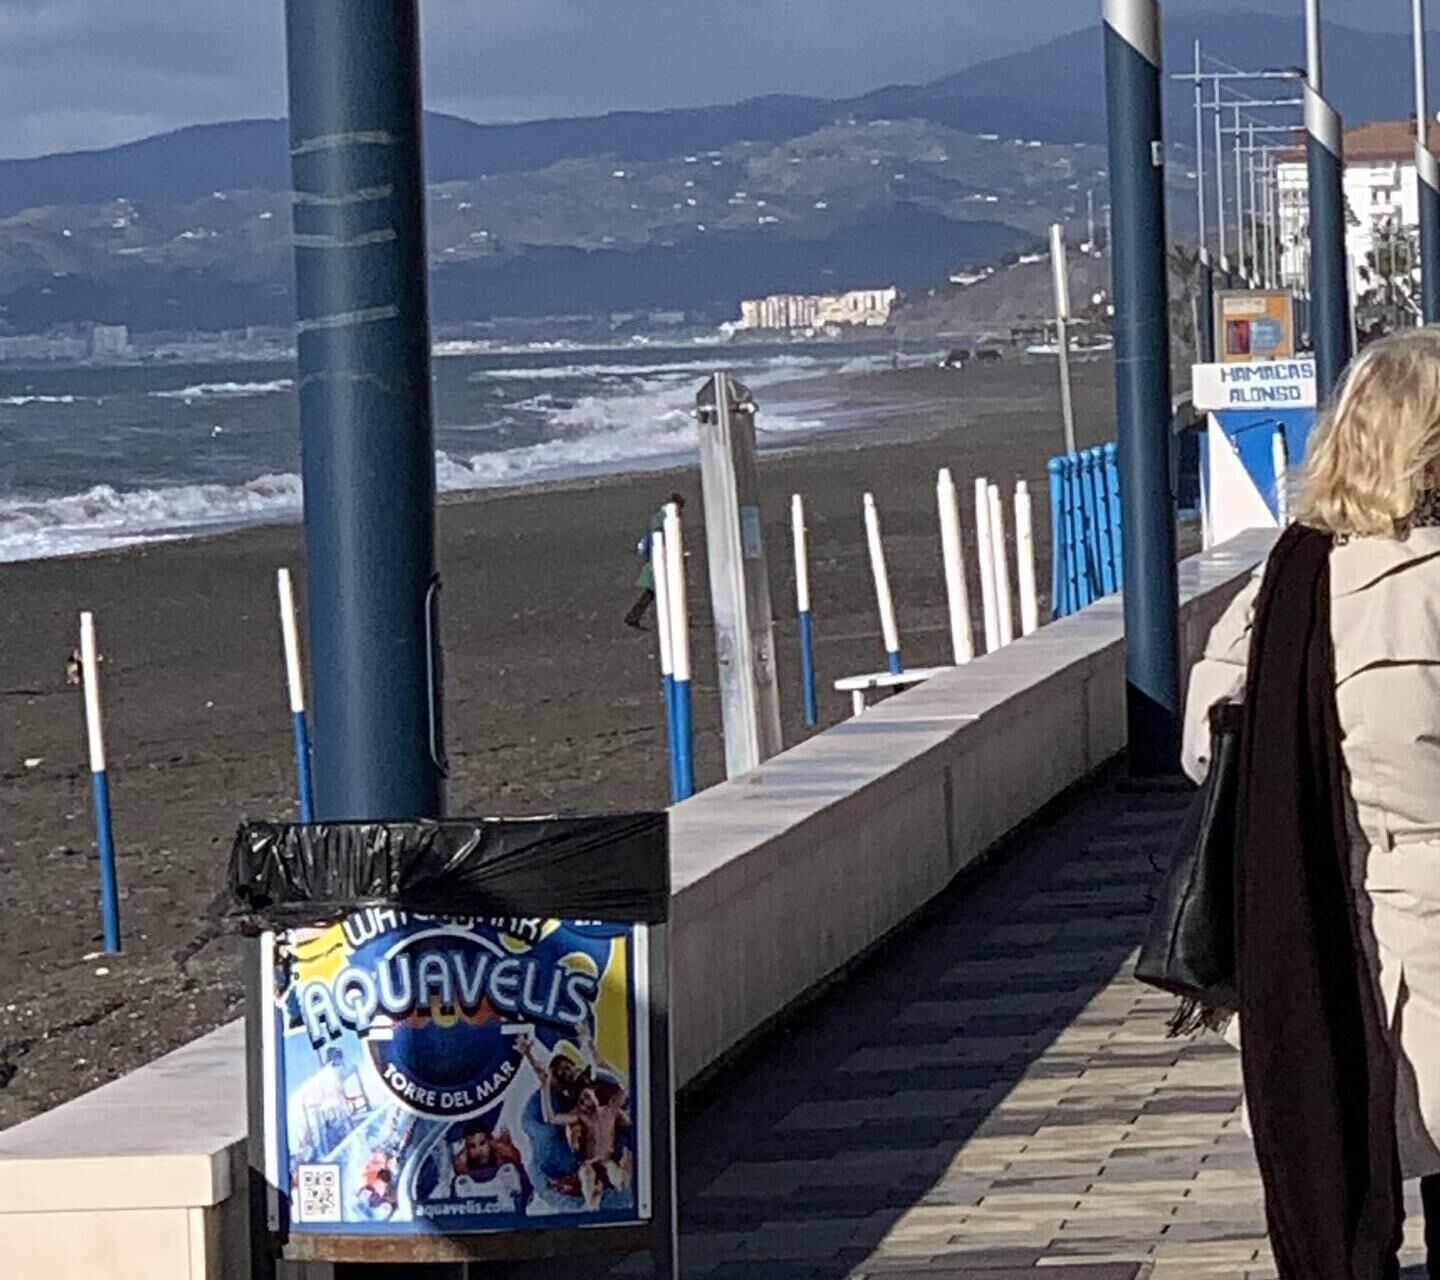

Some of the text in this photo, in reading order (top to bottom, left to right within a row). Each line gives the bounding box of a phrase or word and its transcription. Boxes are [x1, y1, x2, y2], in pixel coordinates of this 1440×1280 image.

[1221, 363, 1313, 383] HAMACAS
[1229, 386, 1301, 402] ALONSO
[301, 952, 599, 1043] AQUAVELIS
[383, 1060, 515, 1109] TORRE DEL MAR
